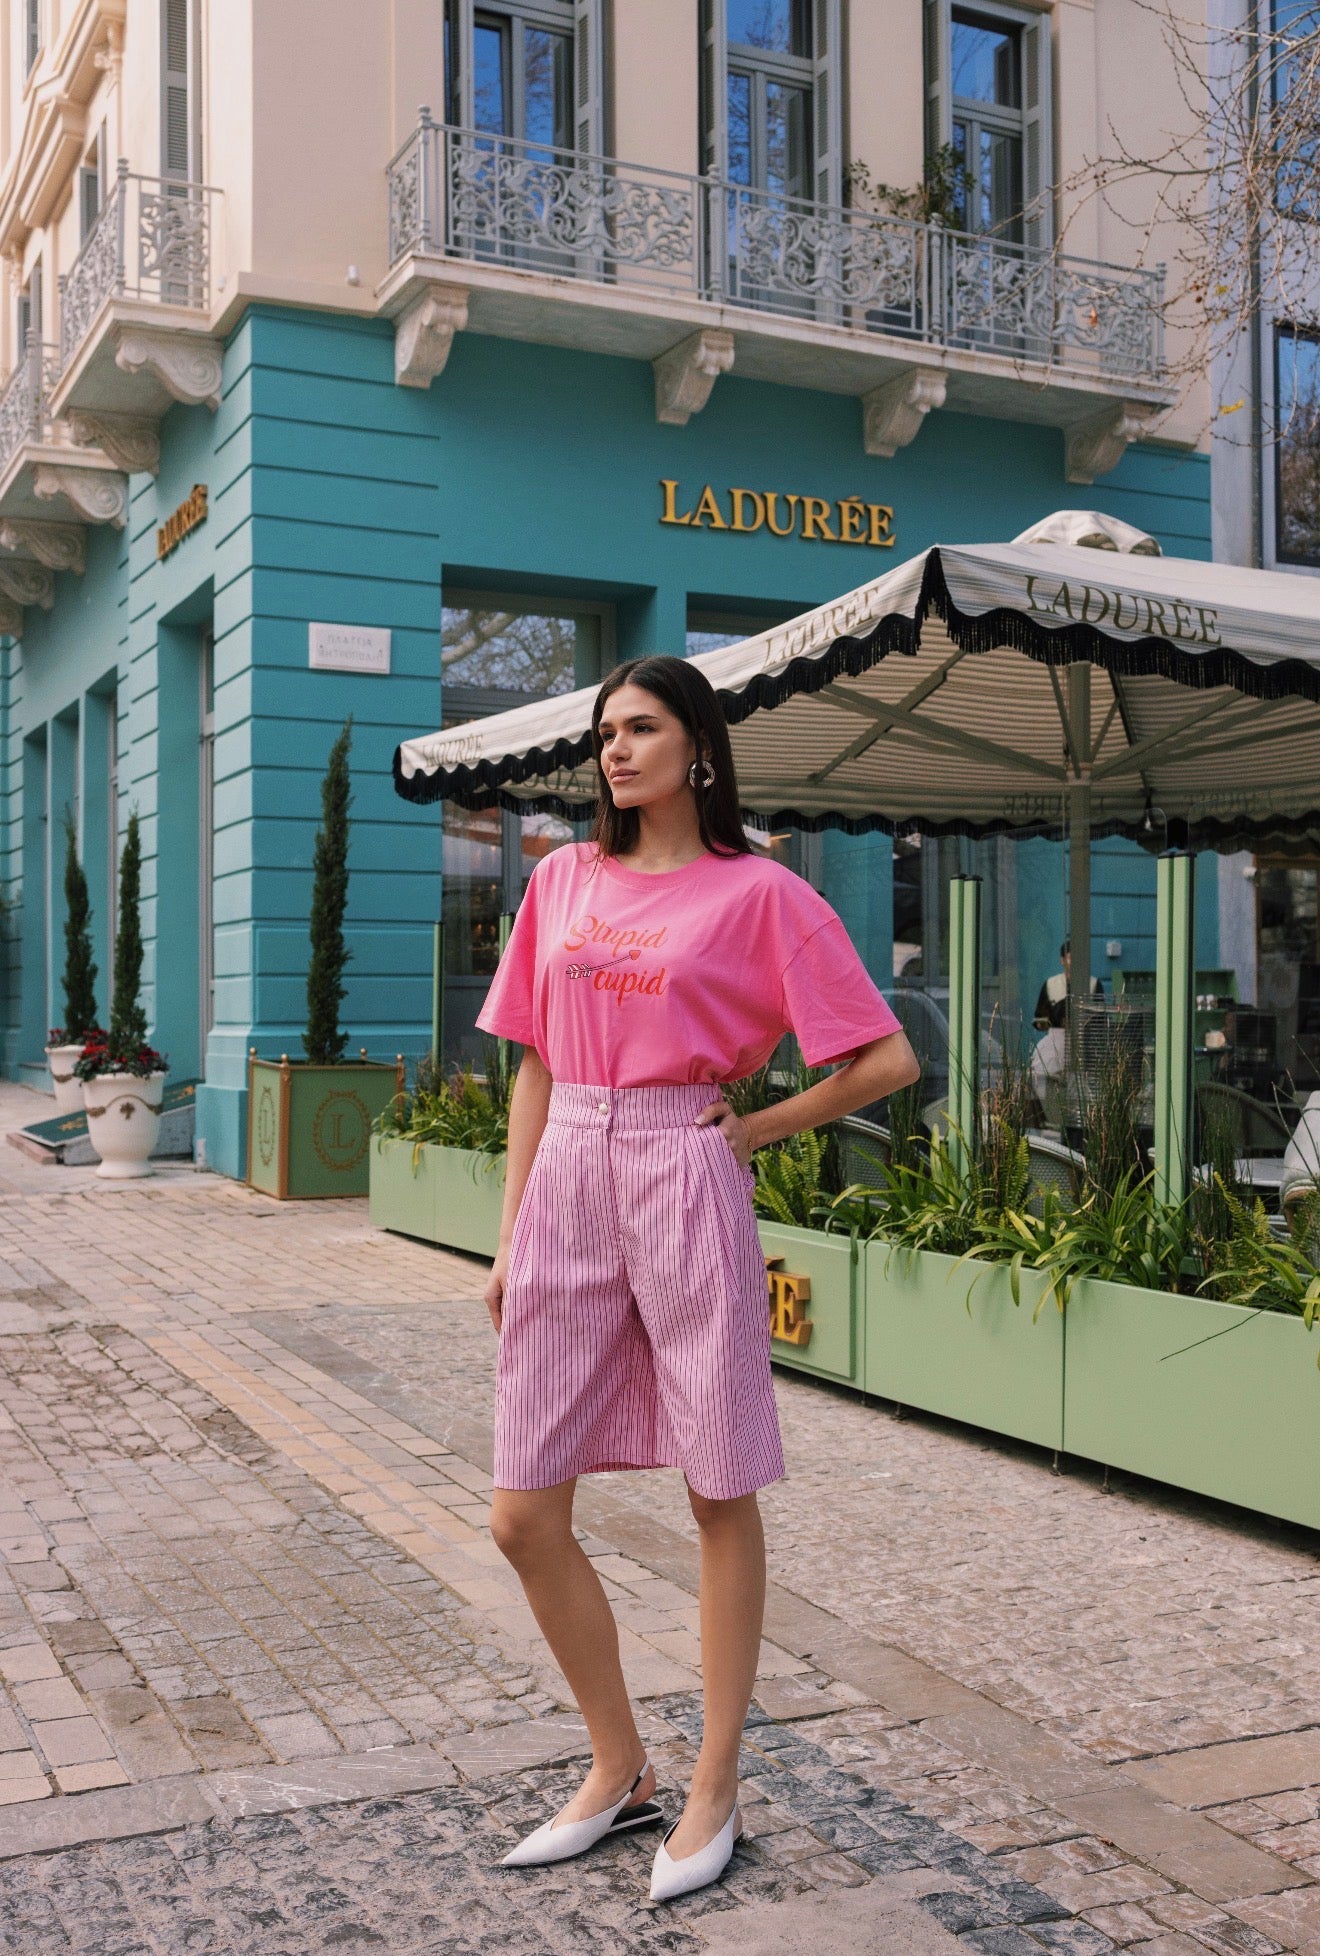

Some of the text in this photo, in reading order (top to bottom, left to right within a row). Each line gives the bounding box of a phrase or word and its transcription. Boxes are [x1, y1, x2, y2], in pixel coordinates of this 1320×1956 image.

[659, 479, 896, 547] LADURÉE
[1024, 575, 1222, 645] LADURÉE
[564, 915, 669, 957] Stupid
[328, 1113, 356, 1149] L
